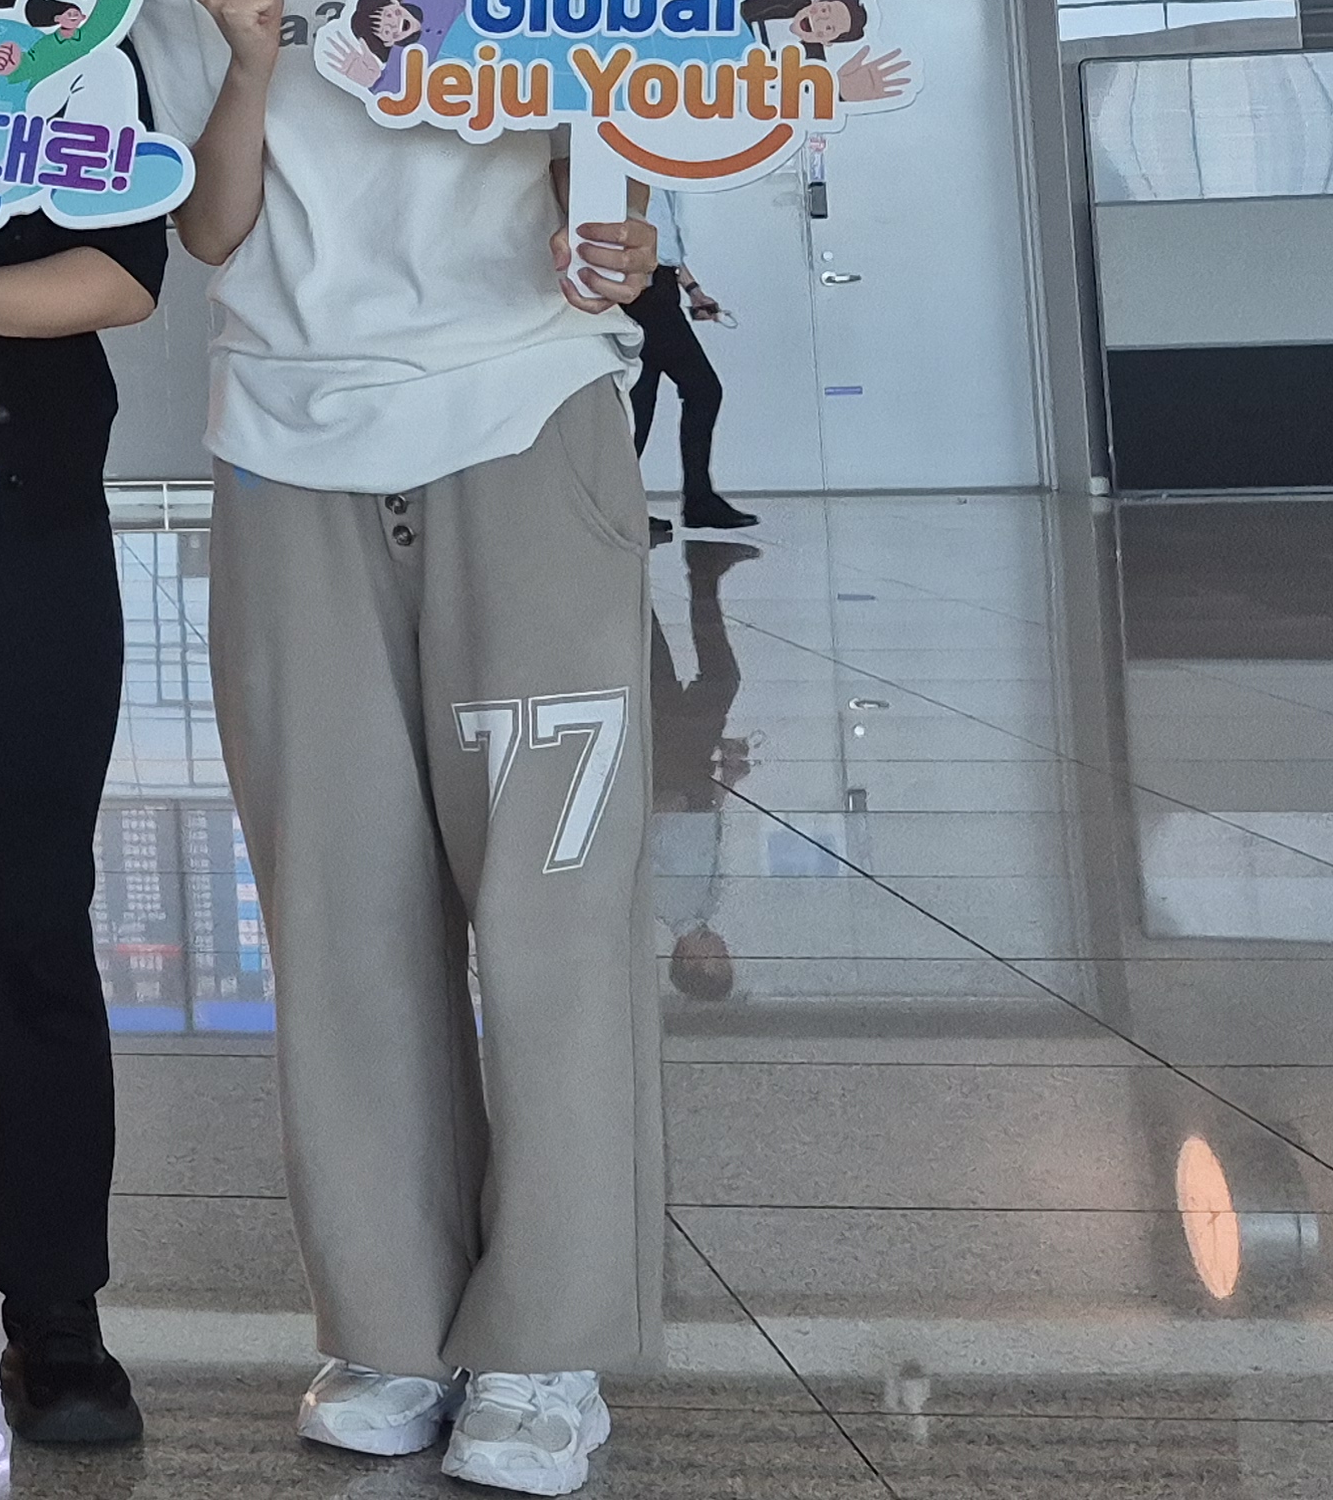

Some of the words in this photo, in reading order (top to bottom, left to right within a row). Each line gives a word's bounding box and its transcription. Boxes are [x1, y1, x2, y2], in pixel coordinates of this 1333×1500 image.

[376, 46, 550, 131] Jeju
[571, 46, 835, 120] Youth
[451, 686, 630, 875] 77
